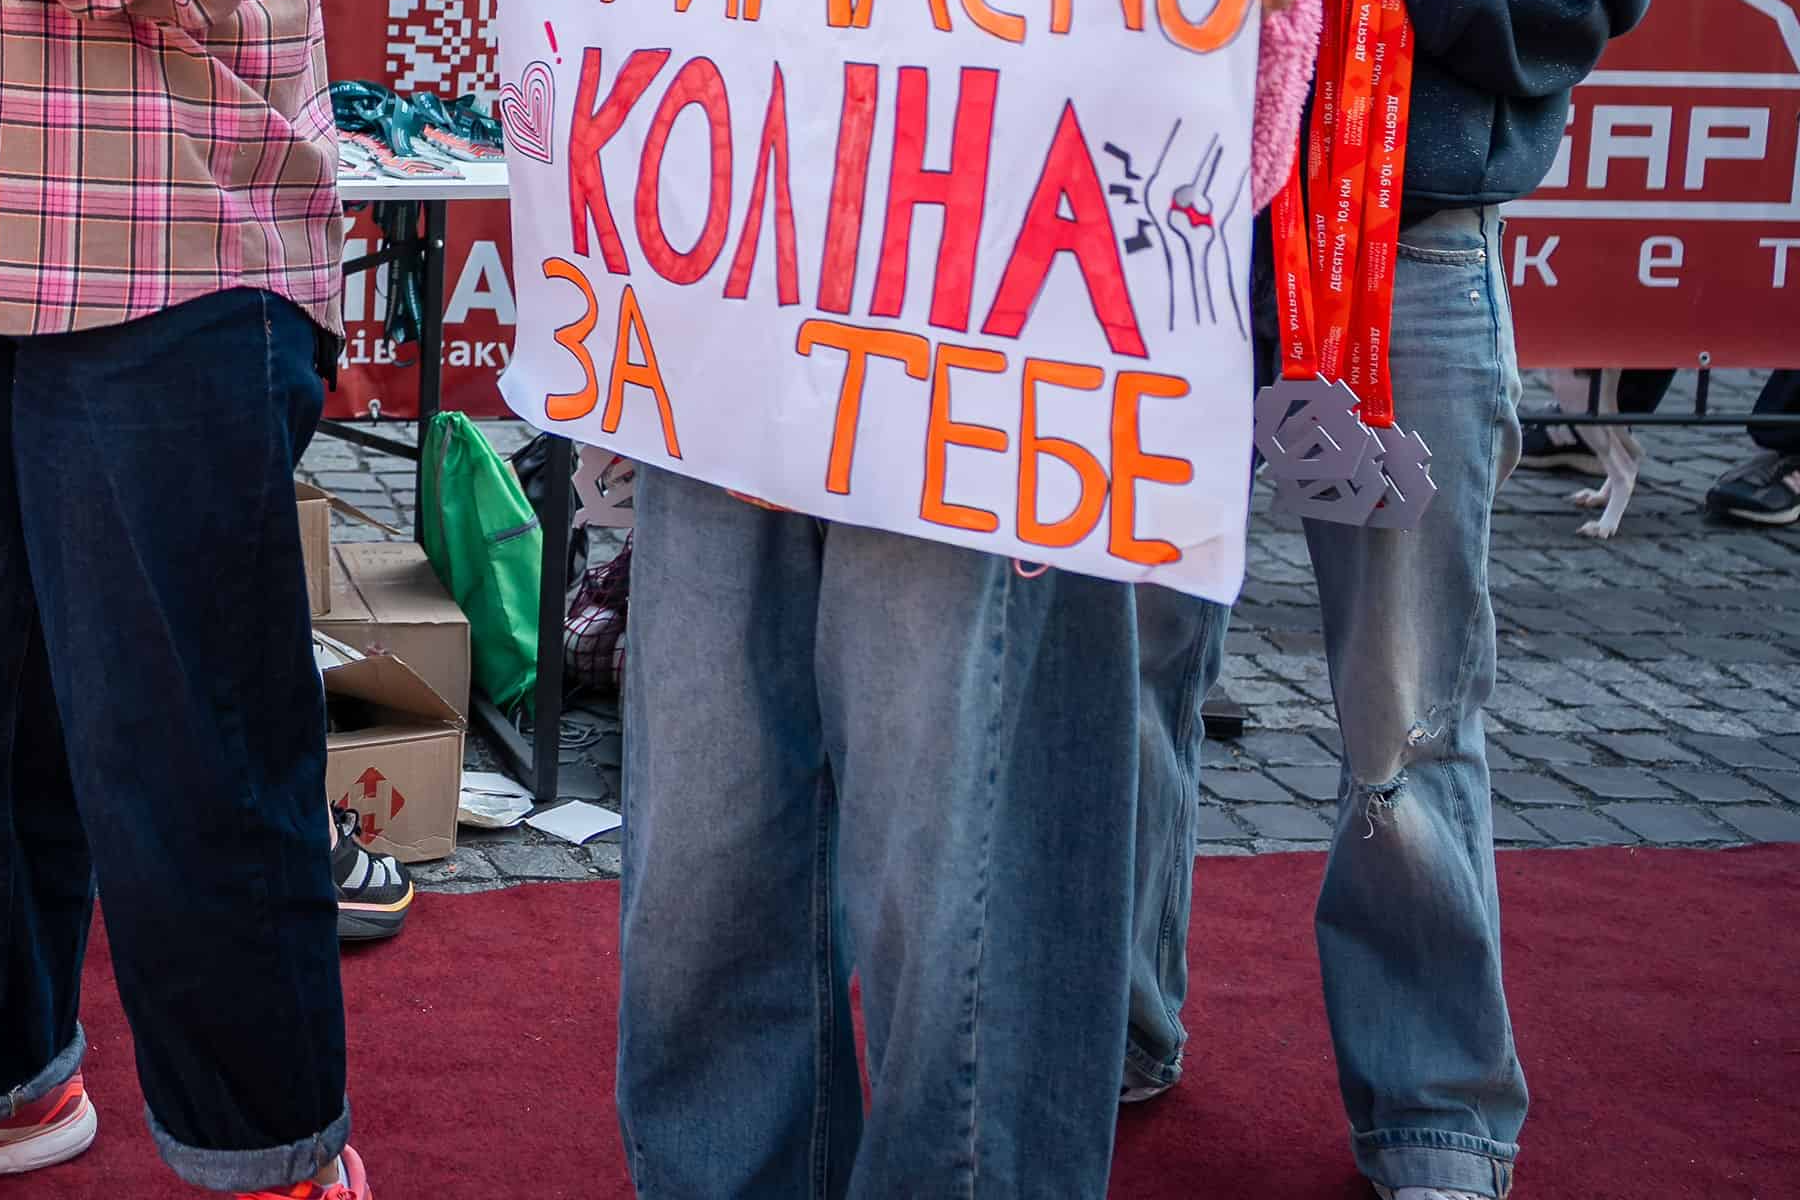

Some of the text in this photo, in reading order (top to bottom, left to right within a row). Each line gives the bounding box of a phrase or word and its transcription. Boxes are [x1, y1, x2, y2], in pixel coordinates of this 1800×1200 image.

[1355, 3, 1370, 63] ДЕСЯТКА
[1383, 95, 1399, 154] ДЕСЯТКА
[568, 47, 1148, 359] КОЛІНА
[1378, 191, 1391, 209] КМ
[1330, 233, 1347, 292] ДЕСЯТКА
[1339, 178, 1353, 198] КМ
[1286, 272, 1299, 332] ДЕСЯТКА
[543, 258, 682, 460] ЗА
[1369, 327, 1381, 386] ДЕСЯТКА
[798, 320, 1194, 567] ТЕБЕ
